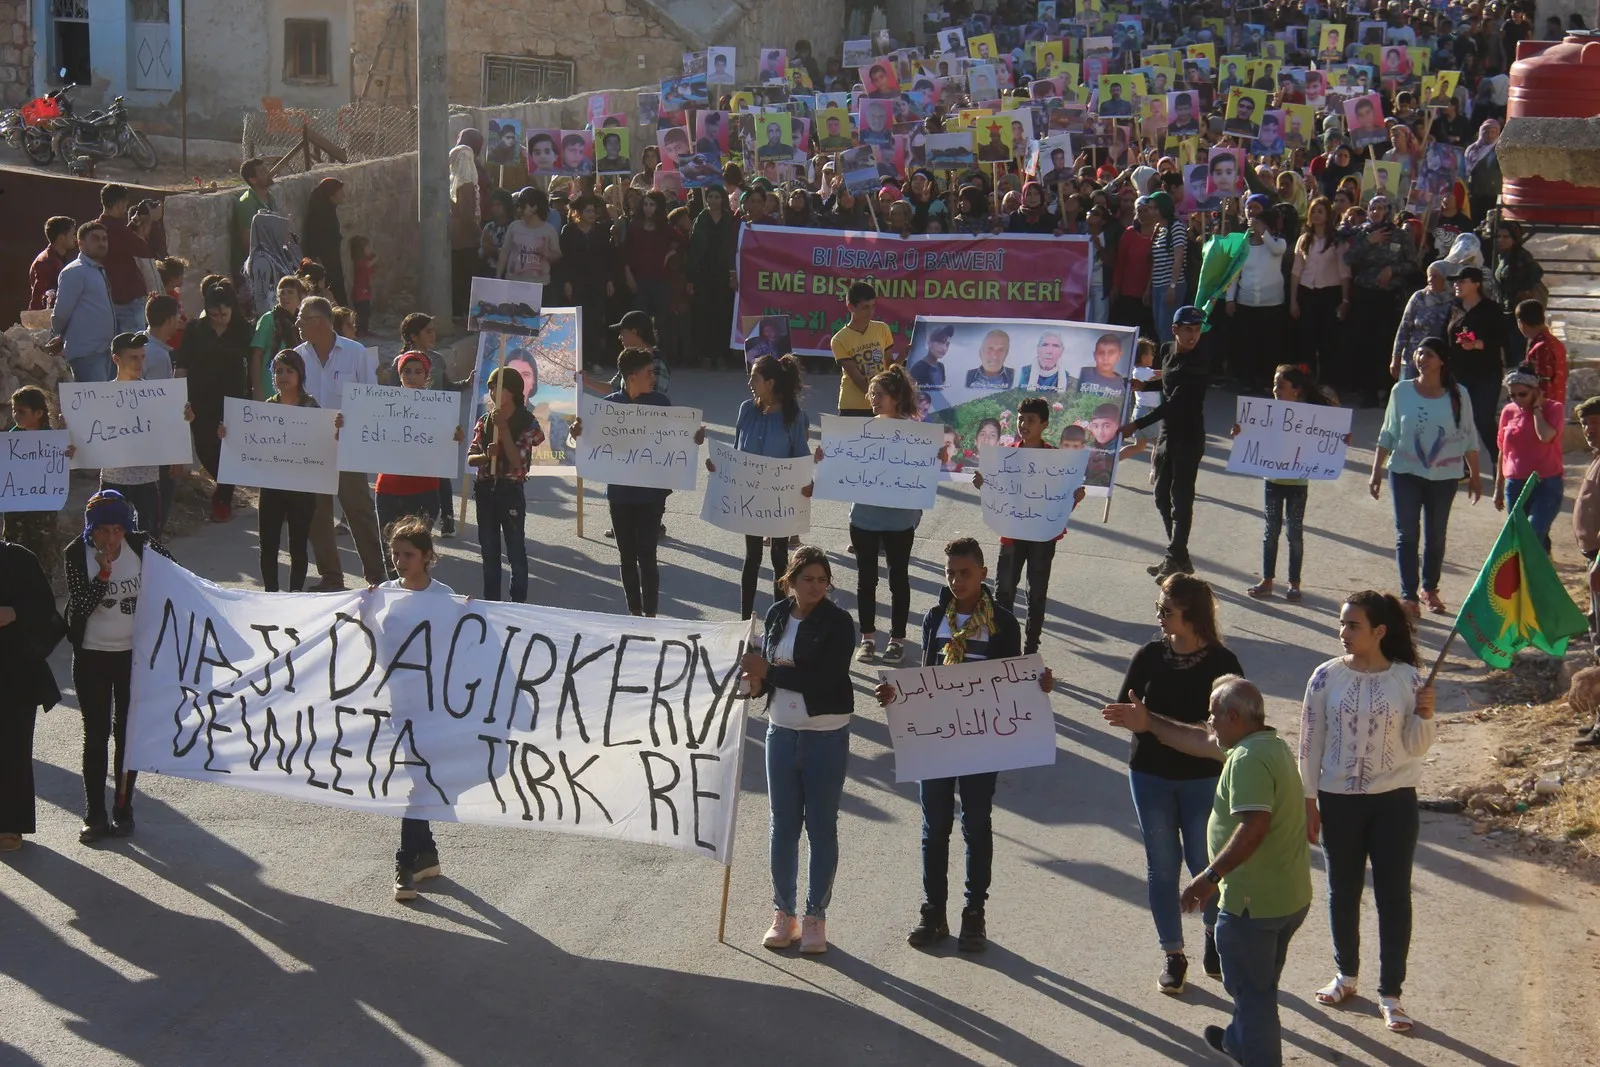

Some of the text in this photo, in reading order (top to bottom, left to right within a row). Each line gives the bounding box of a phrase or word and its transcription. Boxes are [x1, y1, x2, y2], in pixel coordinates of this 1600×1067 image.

[757, 271, 1061, 302] EMÊ BIŞÎNIN DAGIR KERÎ
[812, 246, 832, 266] BI
[903, 247, 919, 271] Û
[150, 597, 243, 687] NA
[639, 750, 721, 852] RE
